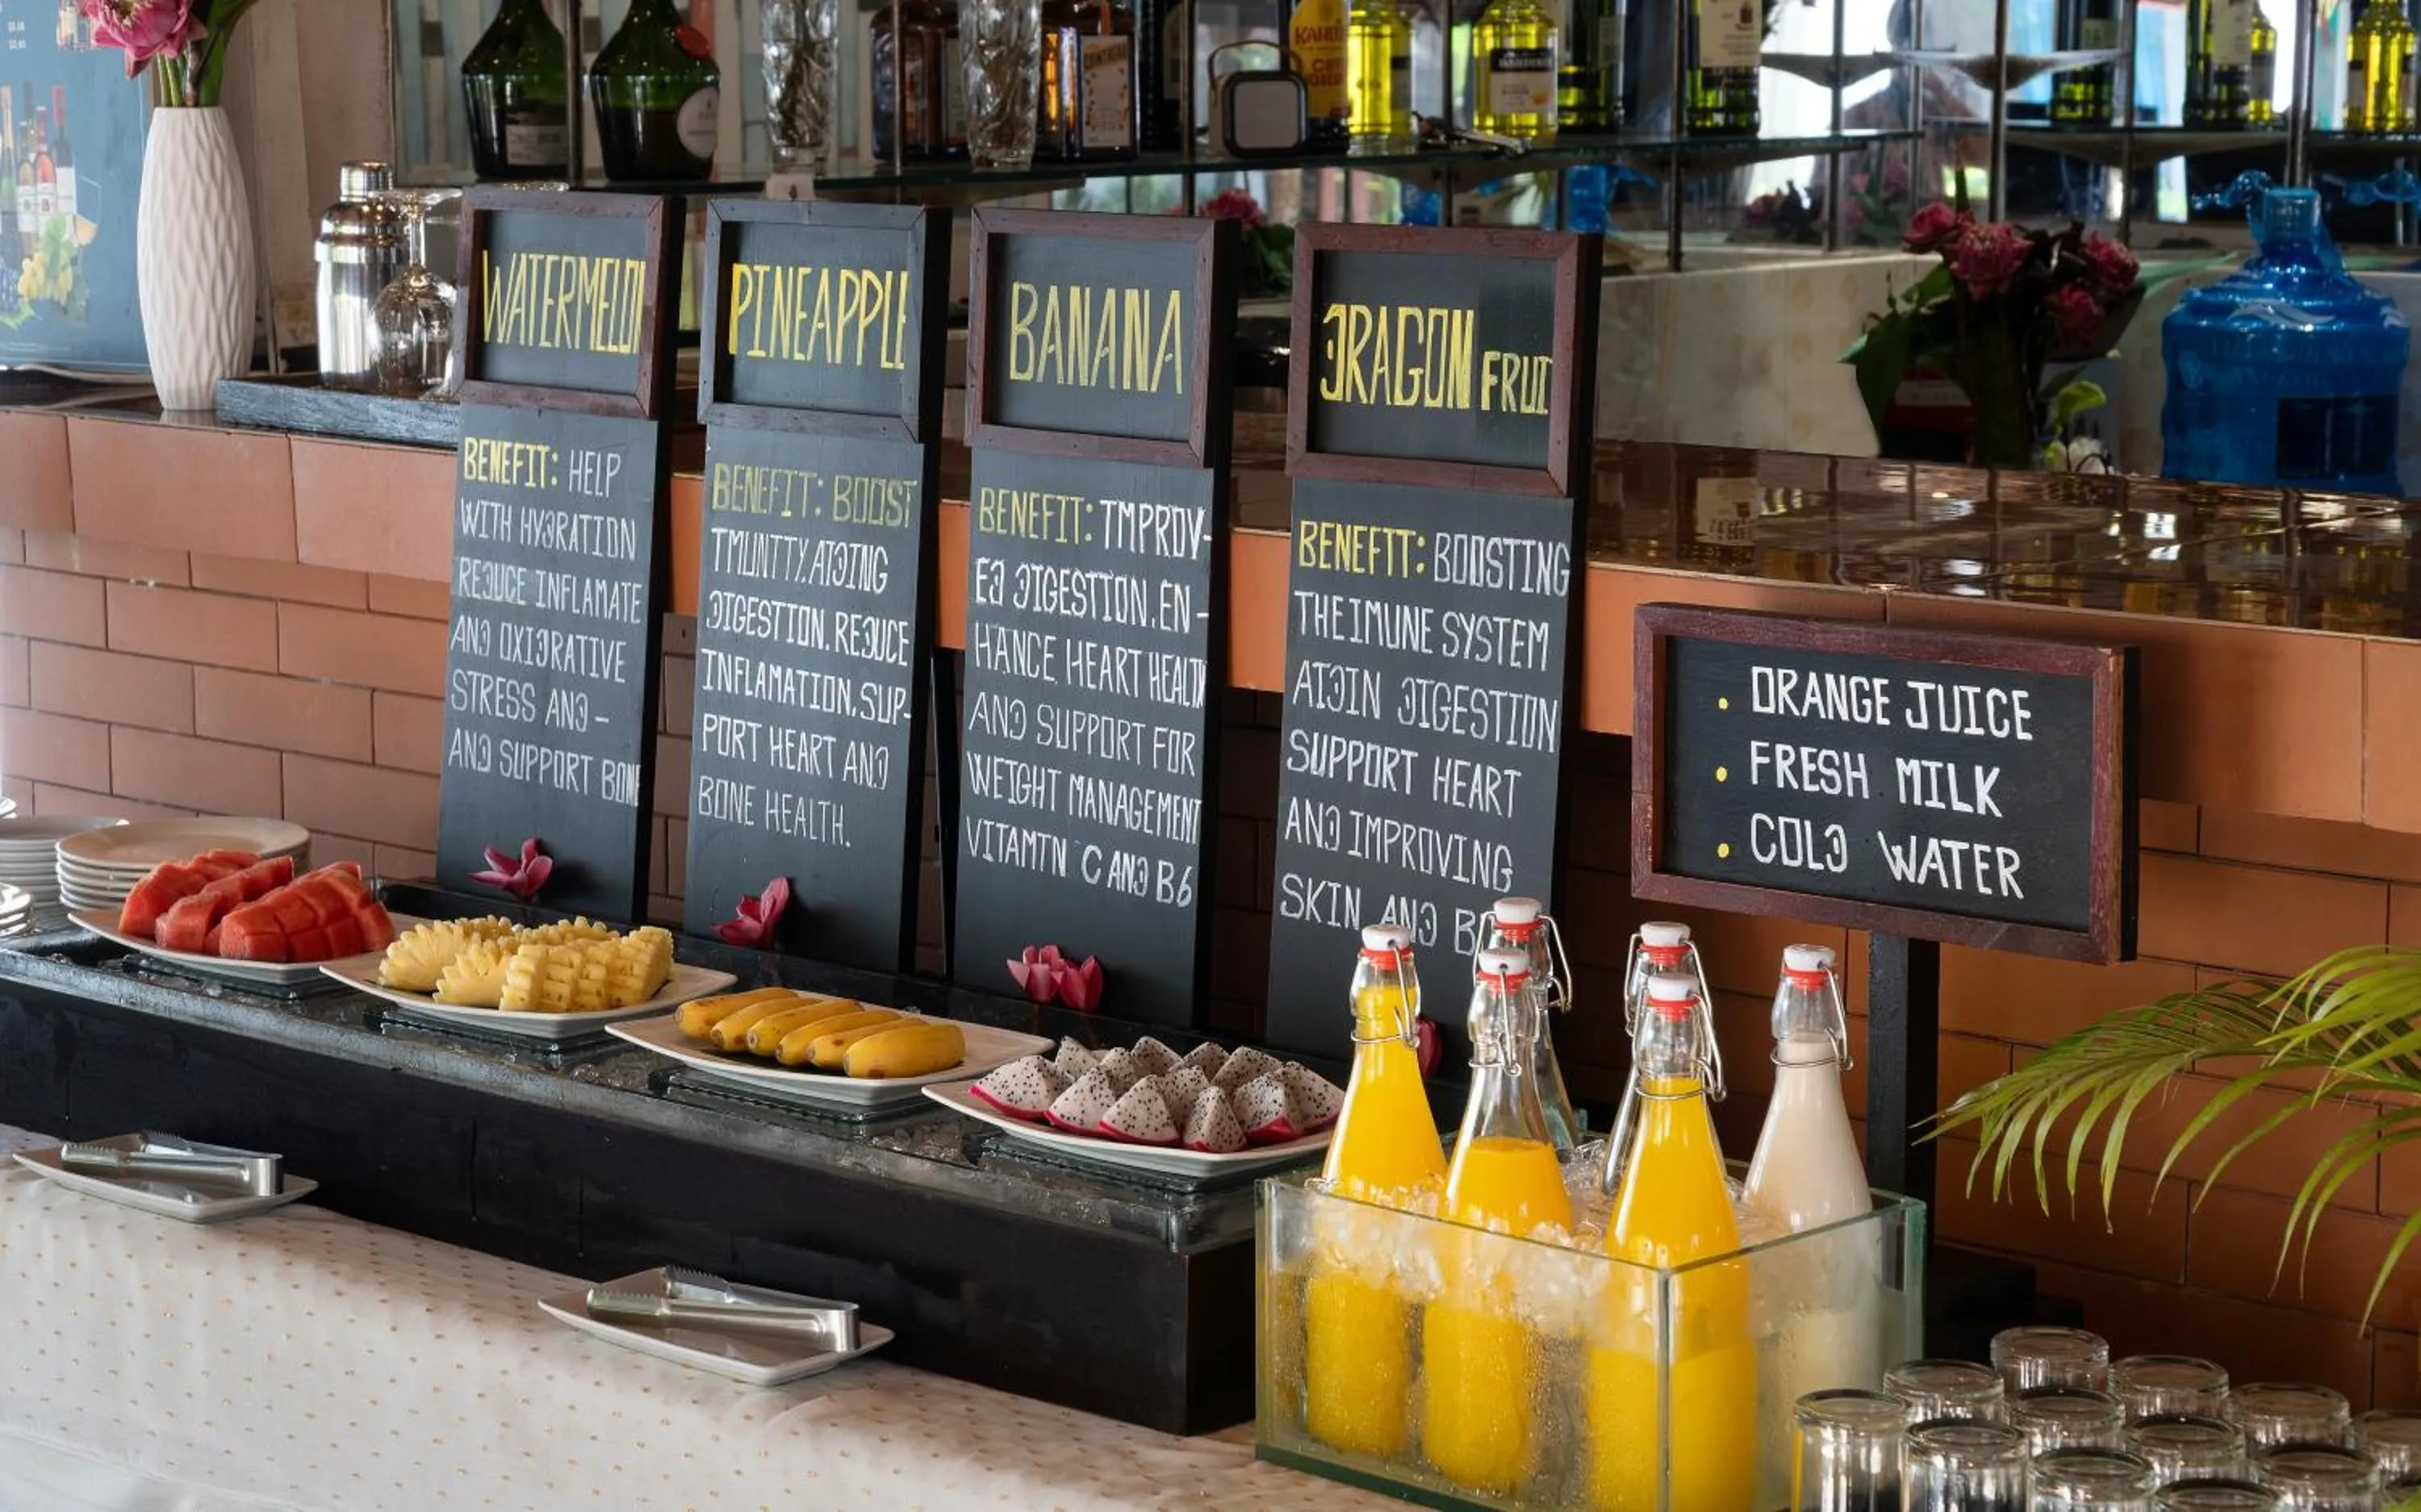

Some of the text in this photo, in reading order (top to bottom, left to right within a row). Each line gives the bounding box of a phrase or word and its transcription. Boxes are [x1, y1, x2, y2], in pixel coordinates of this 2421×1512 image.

[1010, 281, 1182, 394] BANANA
[1320, 303, 1474, 409] DRAGON
[464, 436, 621, 498] BENEFIT: HELP
[711, 462, 918, 528] BENEFIT: BOOST
[461, 497, 636, 562] WITH HYDRATION
[979, 487, 1093, 545] BENEFIT:
[458, 556, 643, 624] REDUCE INFLAMATE
[1299, 520, 1570, 596] BENEFIT: BOOSTING
[450, 614, 491, 658] AND
[835, 611, 910, 666] REDUCE
[975, 621, 1056, 683] HANCE
[1066, 638, 1142, 699] HEART
[1442, 611, 1549, 671] SYSTEM
[452, 669, 536, 723] STRESS
[1397, 677, 1558, 753] DIGESTION
[1752, 666, 2033, 741] ORANGE JUICE
[449, 727, 491, 773] AND
[500, 739, 593, 796] SUPPORT
[702, 713, 889, 790] PORT HEART AND
[968, 692, 1195, 777] AND SUPPORT FOR
[967, 751, 1202, 844] WEIGHT MANAGEMENT
[1286, 729, 1522, 819] SUPPORT HEART
[1750, 740, 2002, 817] FRESH MILK
[698, 775, 851, 848] BONE HEALTH.
[1285, 796, 1513, 893] AND IMPROVING
[1081, 845, 1102, 884] C
[1107, 850, 1148, 897] AND
[1156, 859, 1194, 908] B6
[1750, 812, 2024, 899] COLD WATER
[1281, 873, 1361, 929] SKIN
